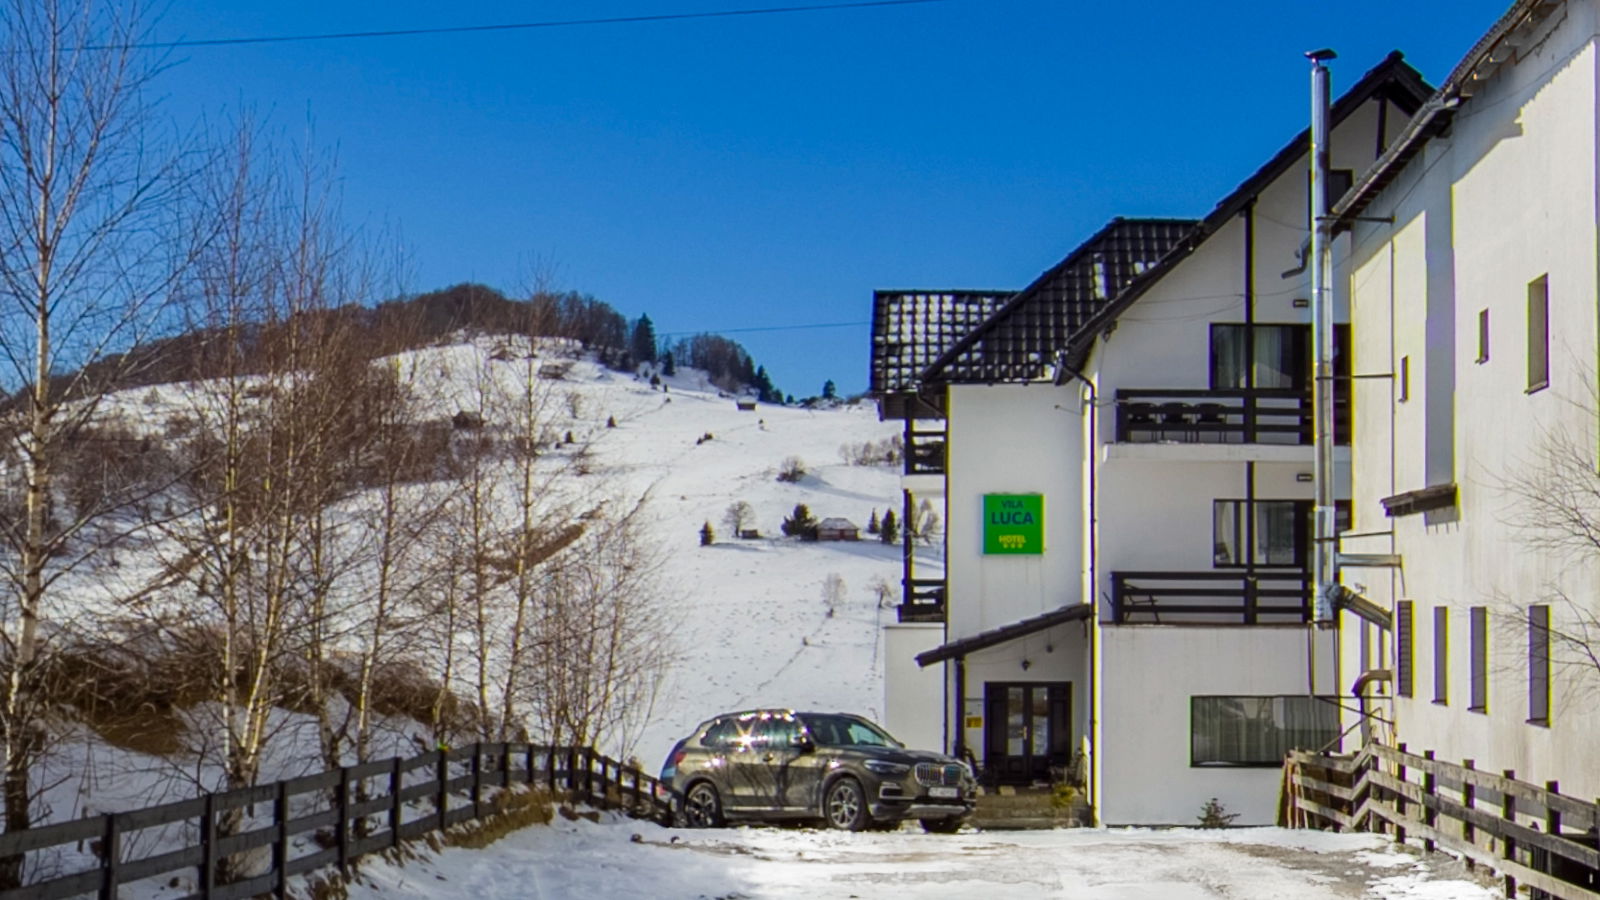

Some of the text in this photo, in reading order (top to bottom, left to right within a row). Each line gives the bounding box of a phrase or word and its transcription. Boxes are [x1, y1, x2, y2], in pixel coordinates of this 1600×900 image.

[1001, 500, 1024, 508] VILA
[991, 511, 1034, 525] LUCA
[998, 534, 1026, 543] HOTEL
